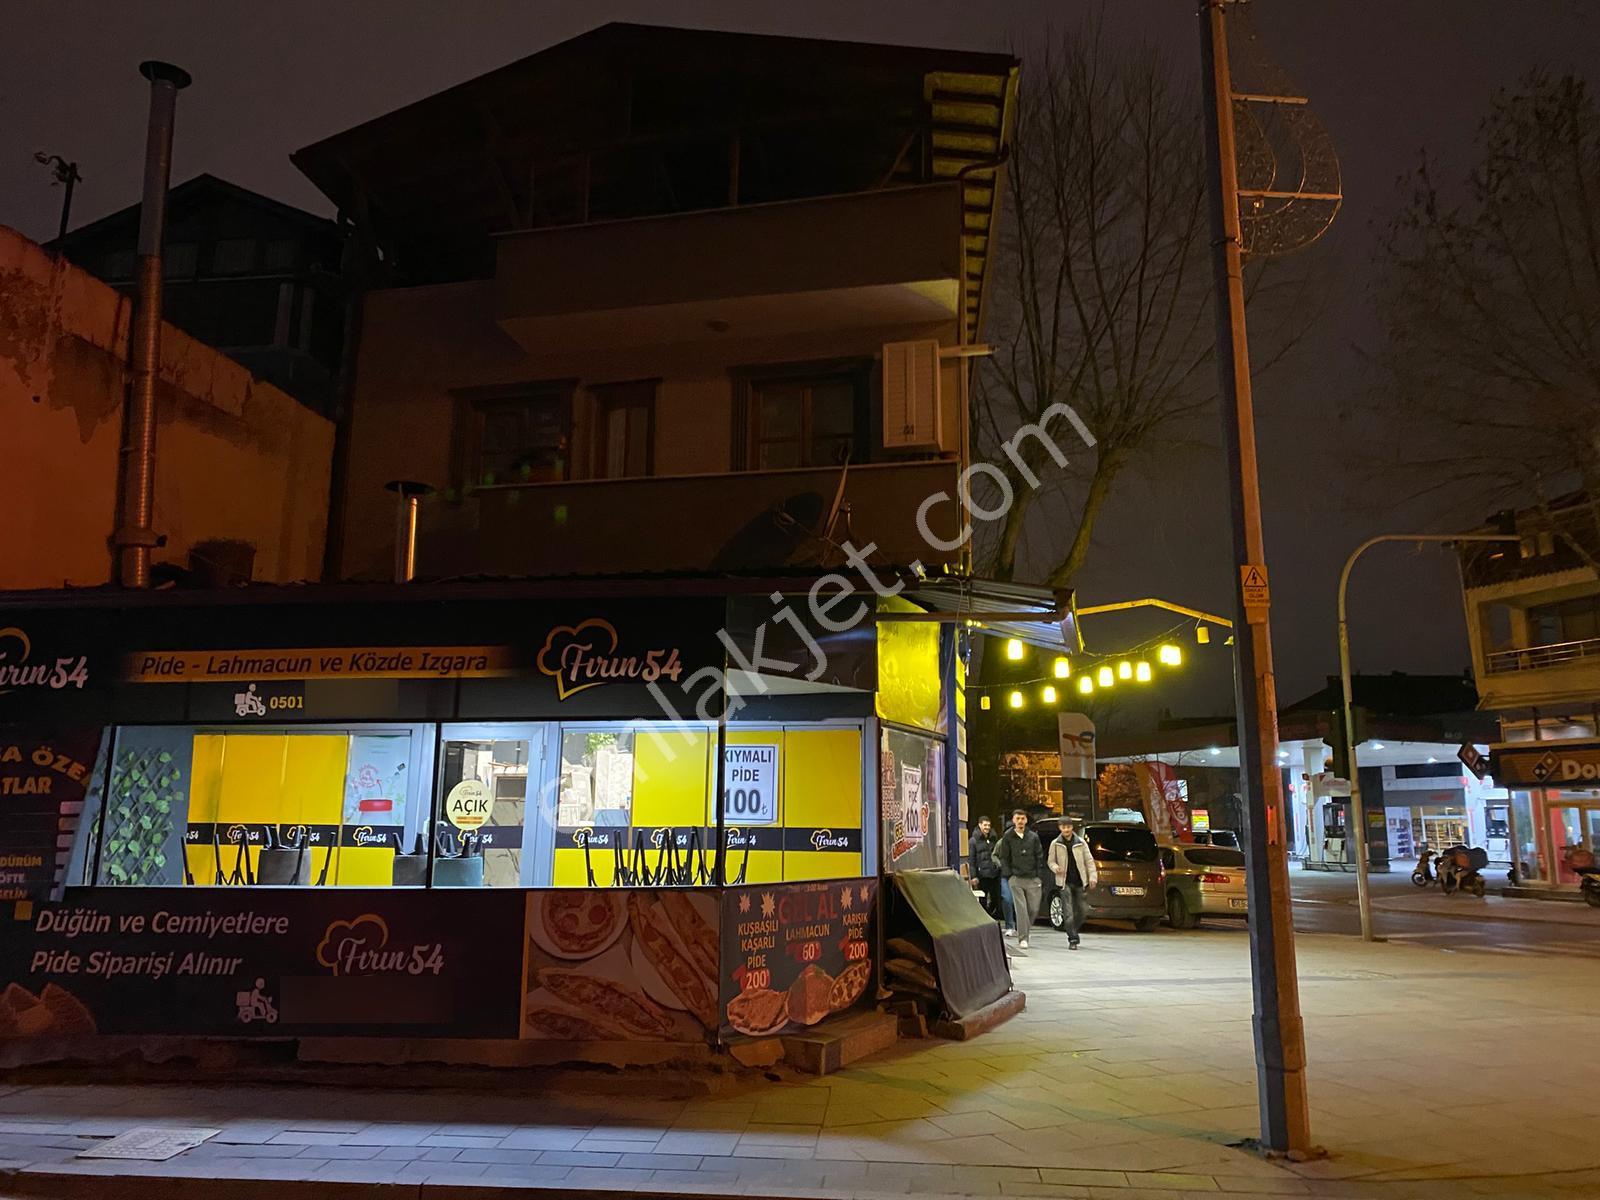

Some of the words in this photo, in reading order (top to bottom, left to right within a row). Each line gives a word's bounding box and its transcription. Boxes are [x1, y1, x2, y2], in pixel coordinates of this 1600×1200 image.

[140, 656, 185, 675] Pide
[206, 653, 312, 675] Lahmacun
[320, 657, 343, 672] ve
[349, 652, 413, 672] Közde
[419, 652, 489, 676] Izgara
[269, 696, 304, 710] 0501
[0, 746, 22, 762] A
[724, 750, 771, 763] KIYMALI
[732, 766, 760, 782] PİDE
[1561, 759, 1600, 779] Do
[1, 776, 52, 795] TLAR
[453, 800, 488, 815] AÇIK
[0, 854, 42, 867] DÜRÜM
[0, 871, 25, 884] ÖFTE
[35, 909, 111, 938] Düğün
[119, 915, 145, 934] ve
[151, 910, 289, 939] Cemiyetlere
[842, 912, 868, 926] KARIŞIK
[738, 919, 779, 937] KUŞBAŞILI
[785, 923, 830, 941] LAHMACUN
[848, 927, 864, 940] PİDE
[741, 936, 775, 953] KAŞARLI
[30, 951, 80, 974] Pide
[86, 951, 174, 980] Siparişi
[177, 952, 242, 976] Alınır
[747, 954, 767, 969] PİDE
